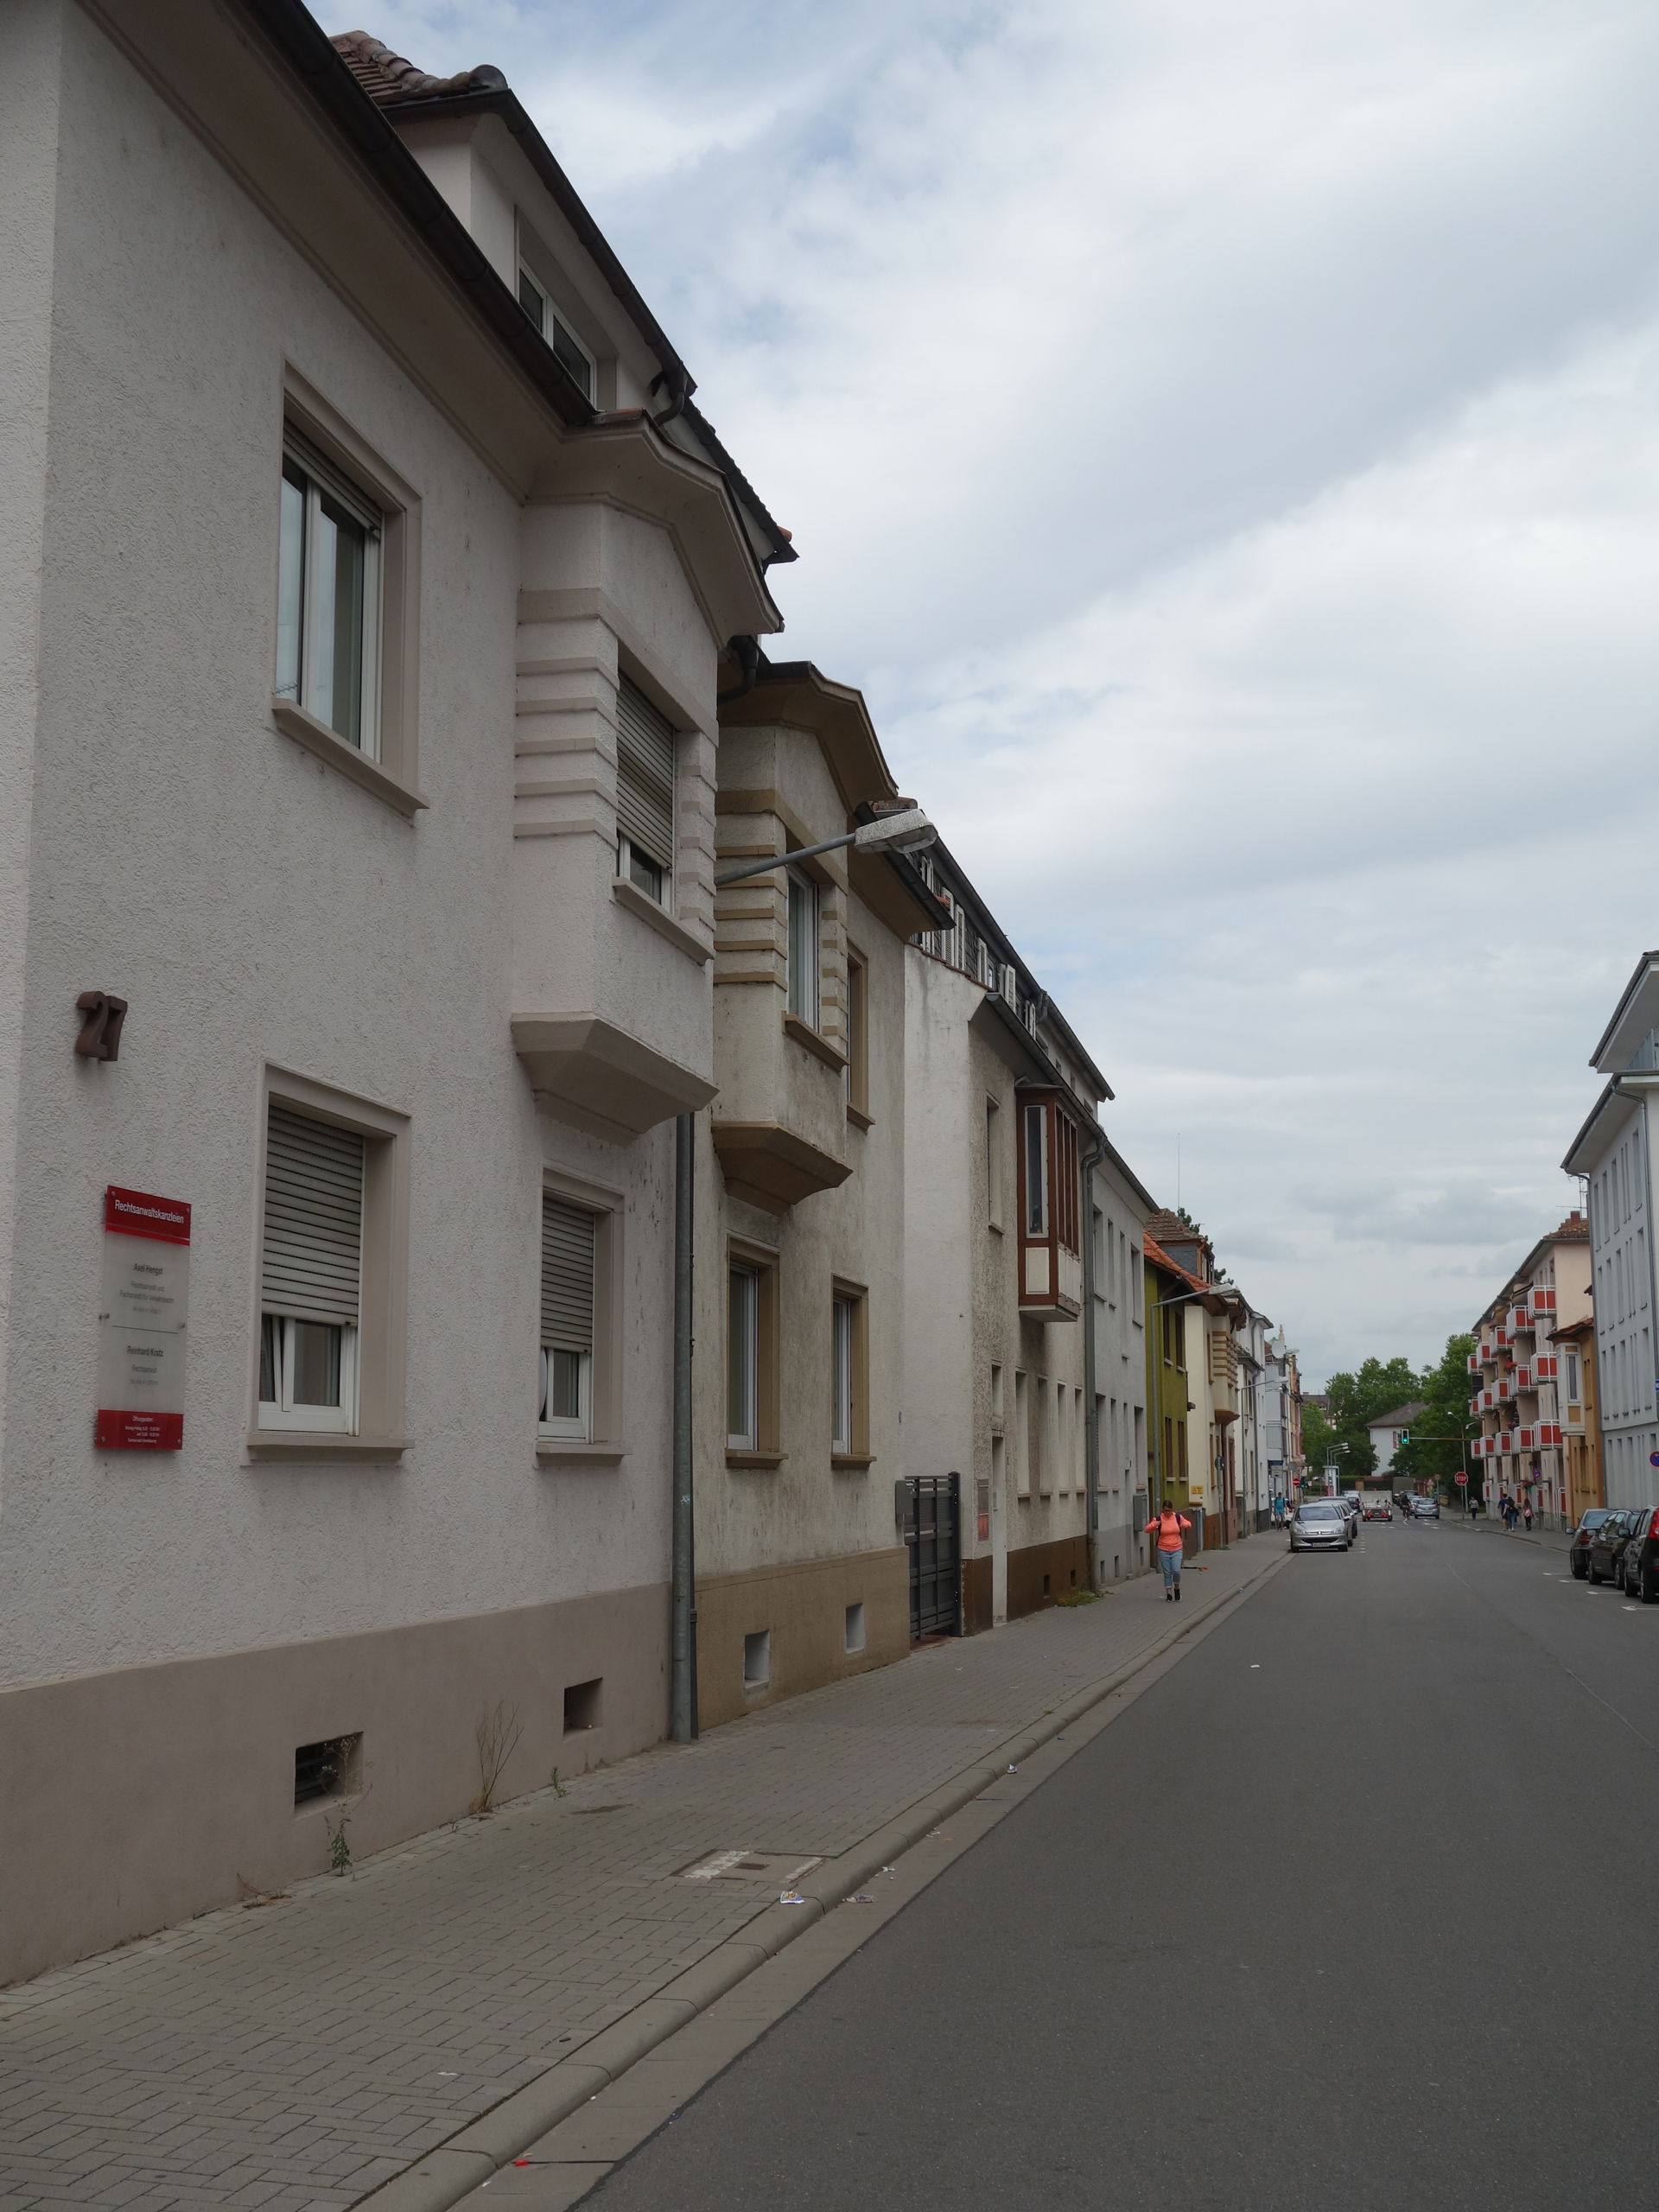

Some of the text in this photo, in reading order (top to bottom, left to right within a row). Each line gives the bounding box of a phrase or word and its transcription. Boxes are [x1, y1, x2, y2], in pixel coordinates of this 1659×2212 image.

[75, 990, 128, 1062] 27
[114, 1199, 184, 1224] Rechtsanwaltskanzleien
[145, 1264, 163, 1277] Hengst
